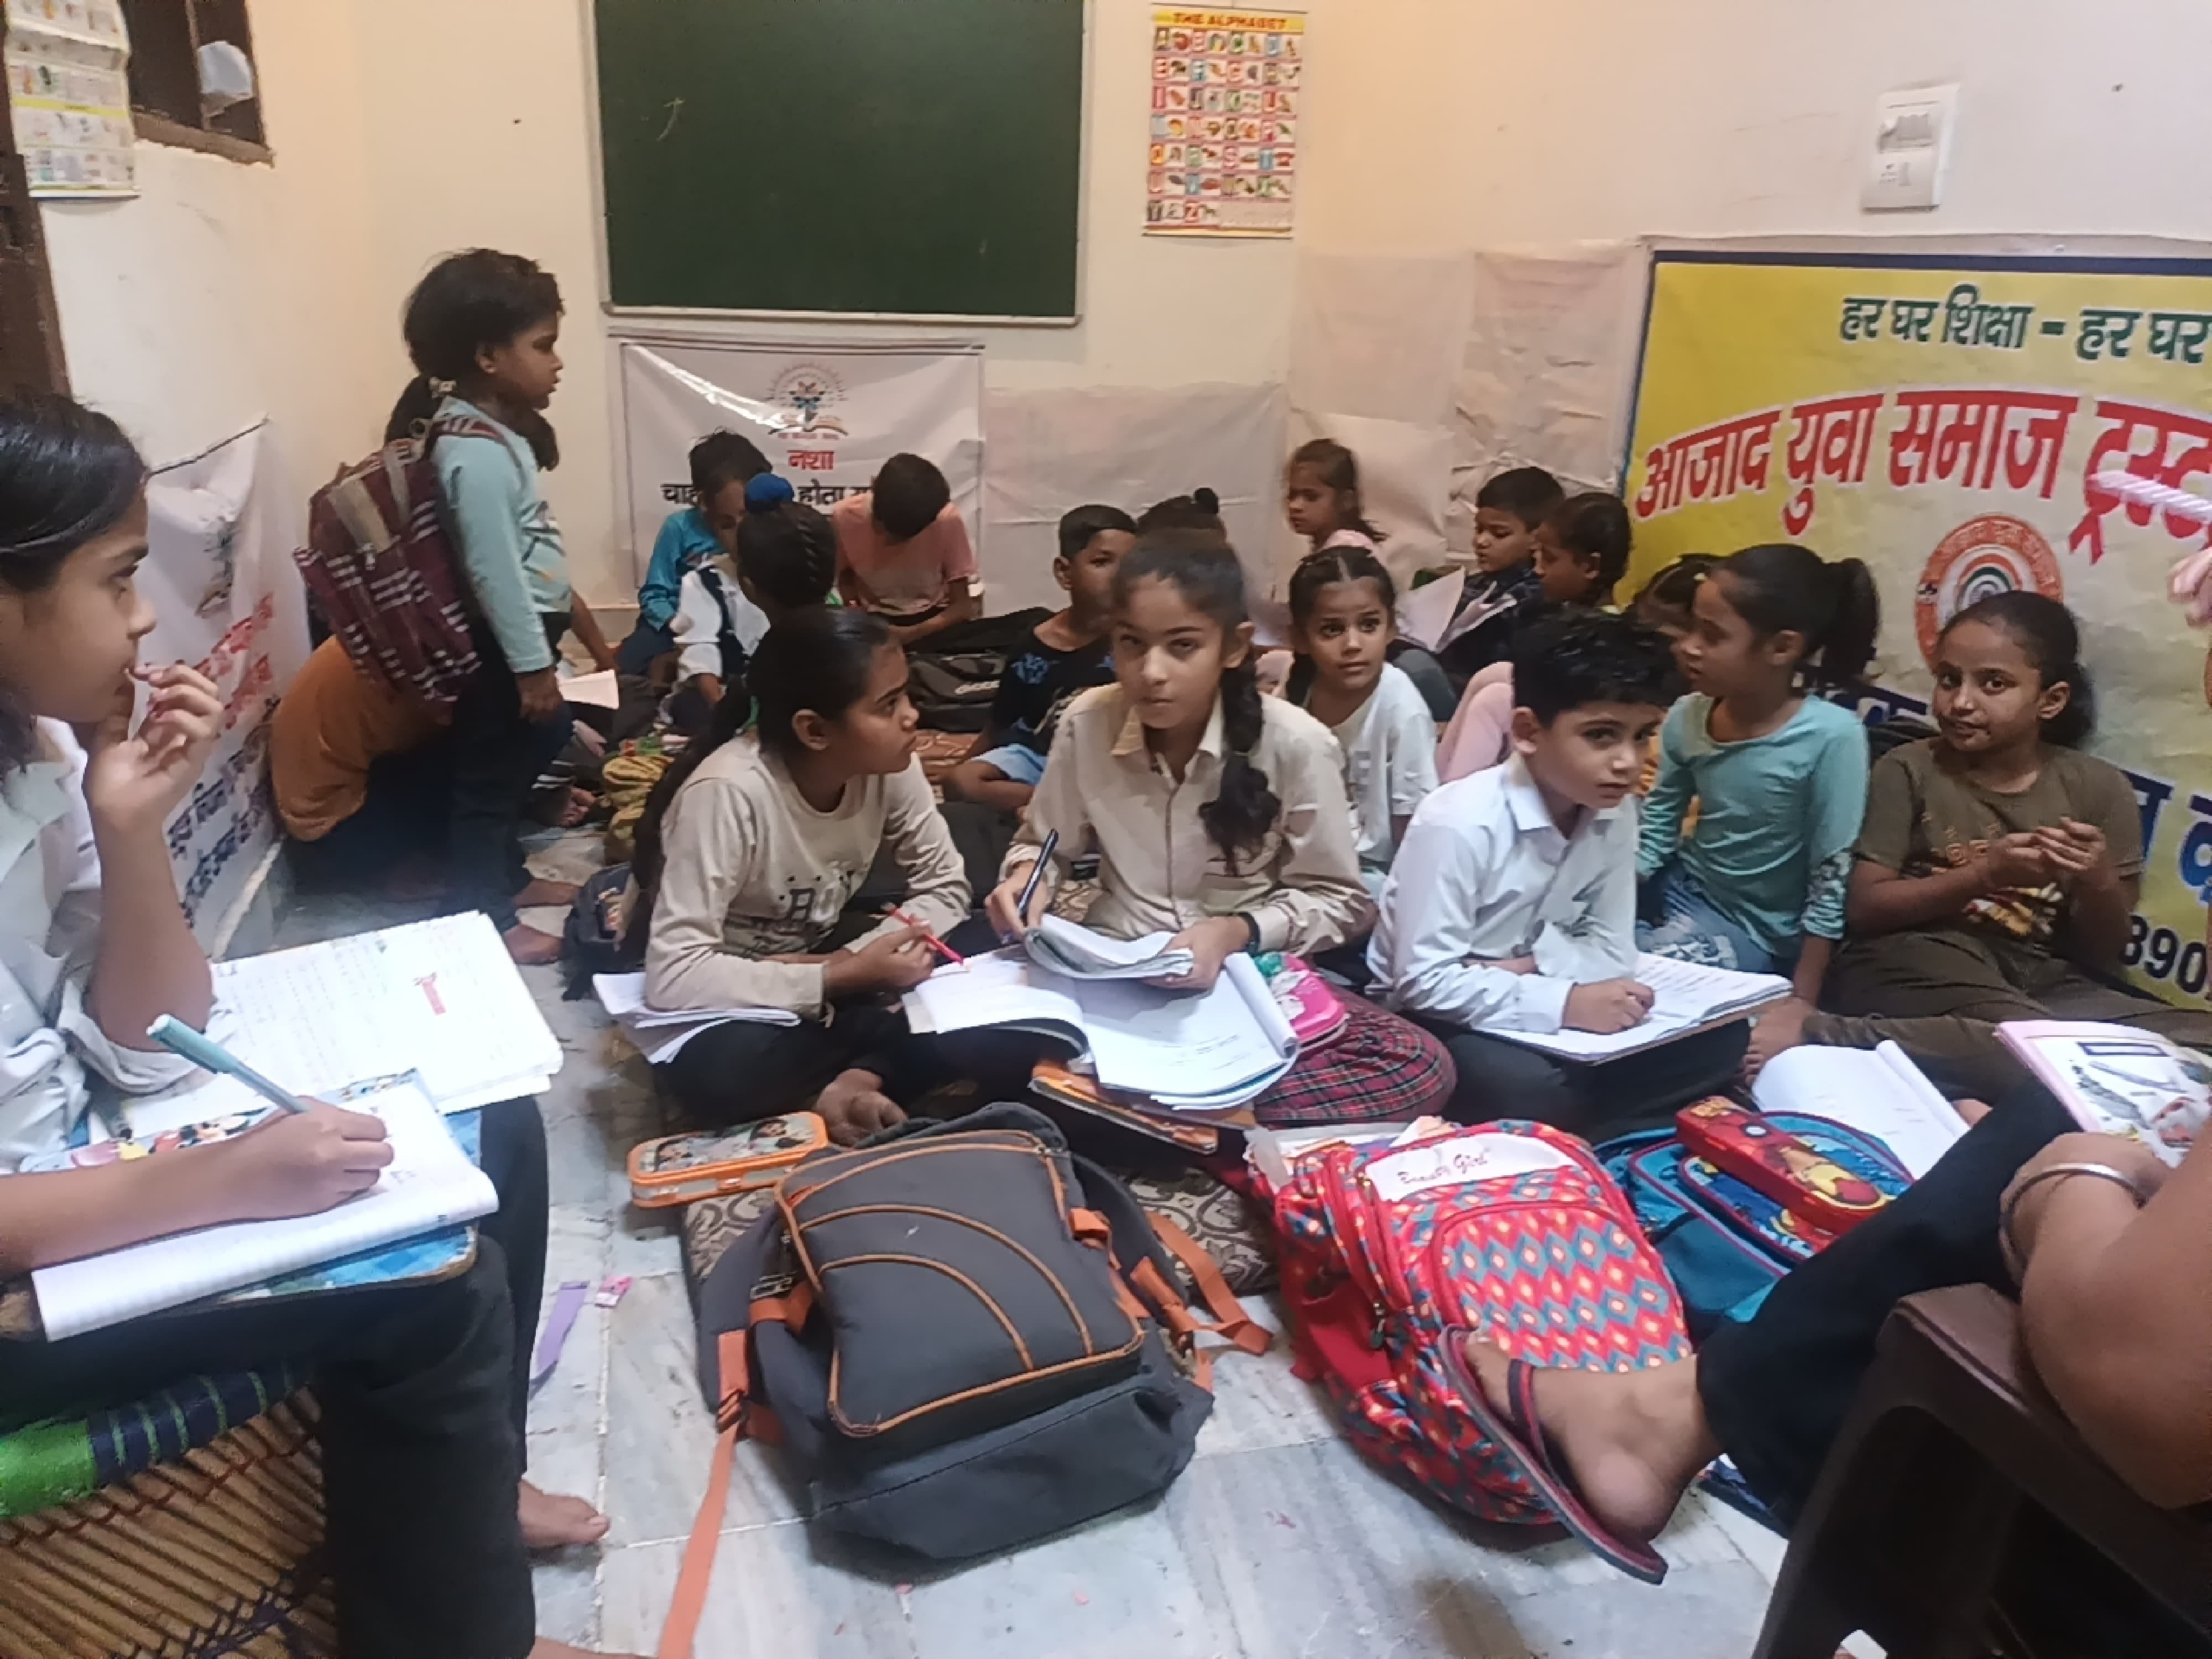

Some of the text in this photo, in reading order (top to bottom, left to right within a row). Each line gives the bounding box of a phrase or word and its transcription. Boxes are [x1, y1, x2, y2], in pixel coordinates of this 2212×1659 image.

[1840, 297, 1886, 341] हर
[1890, 300, 1939, 343] घर
[1941, 283, 2034, 348] शिक्षा
[2076, 309, 2143, 361] हर
[787, 450, 834, 471] नशा
[1635, 410, 1781, 518] आजाद
[1781, 394, 1883, 535] युवा
[1889, 390, 2079, 499] समाज
